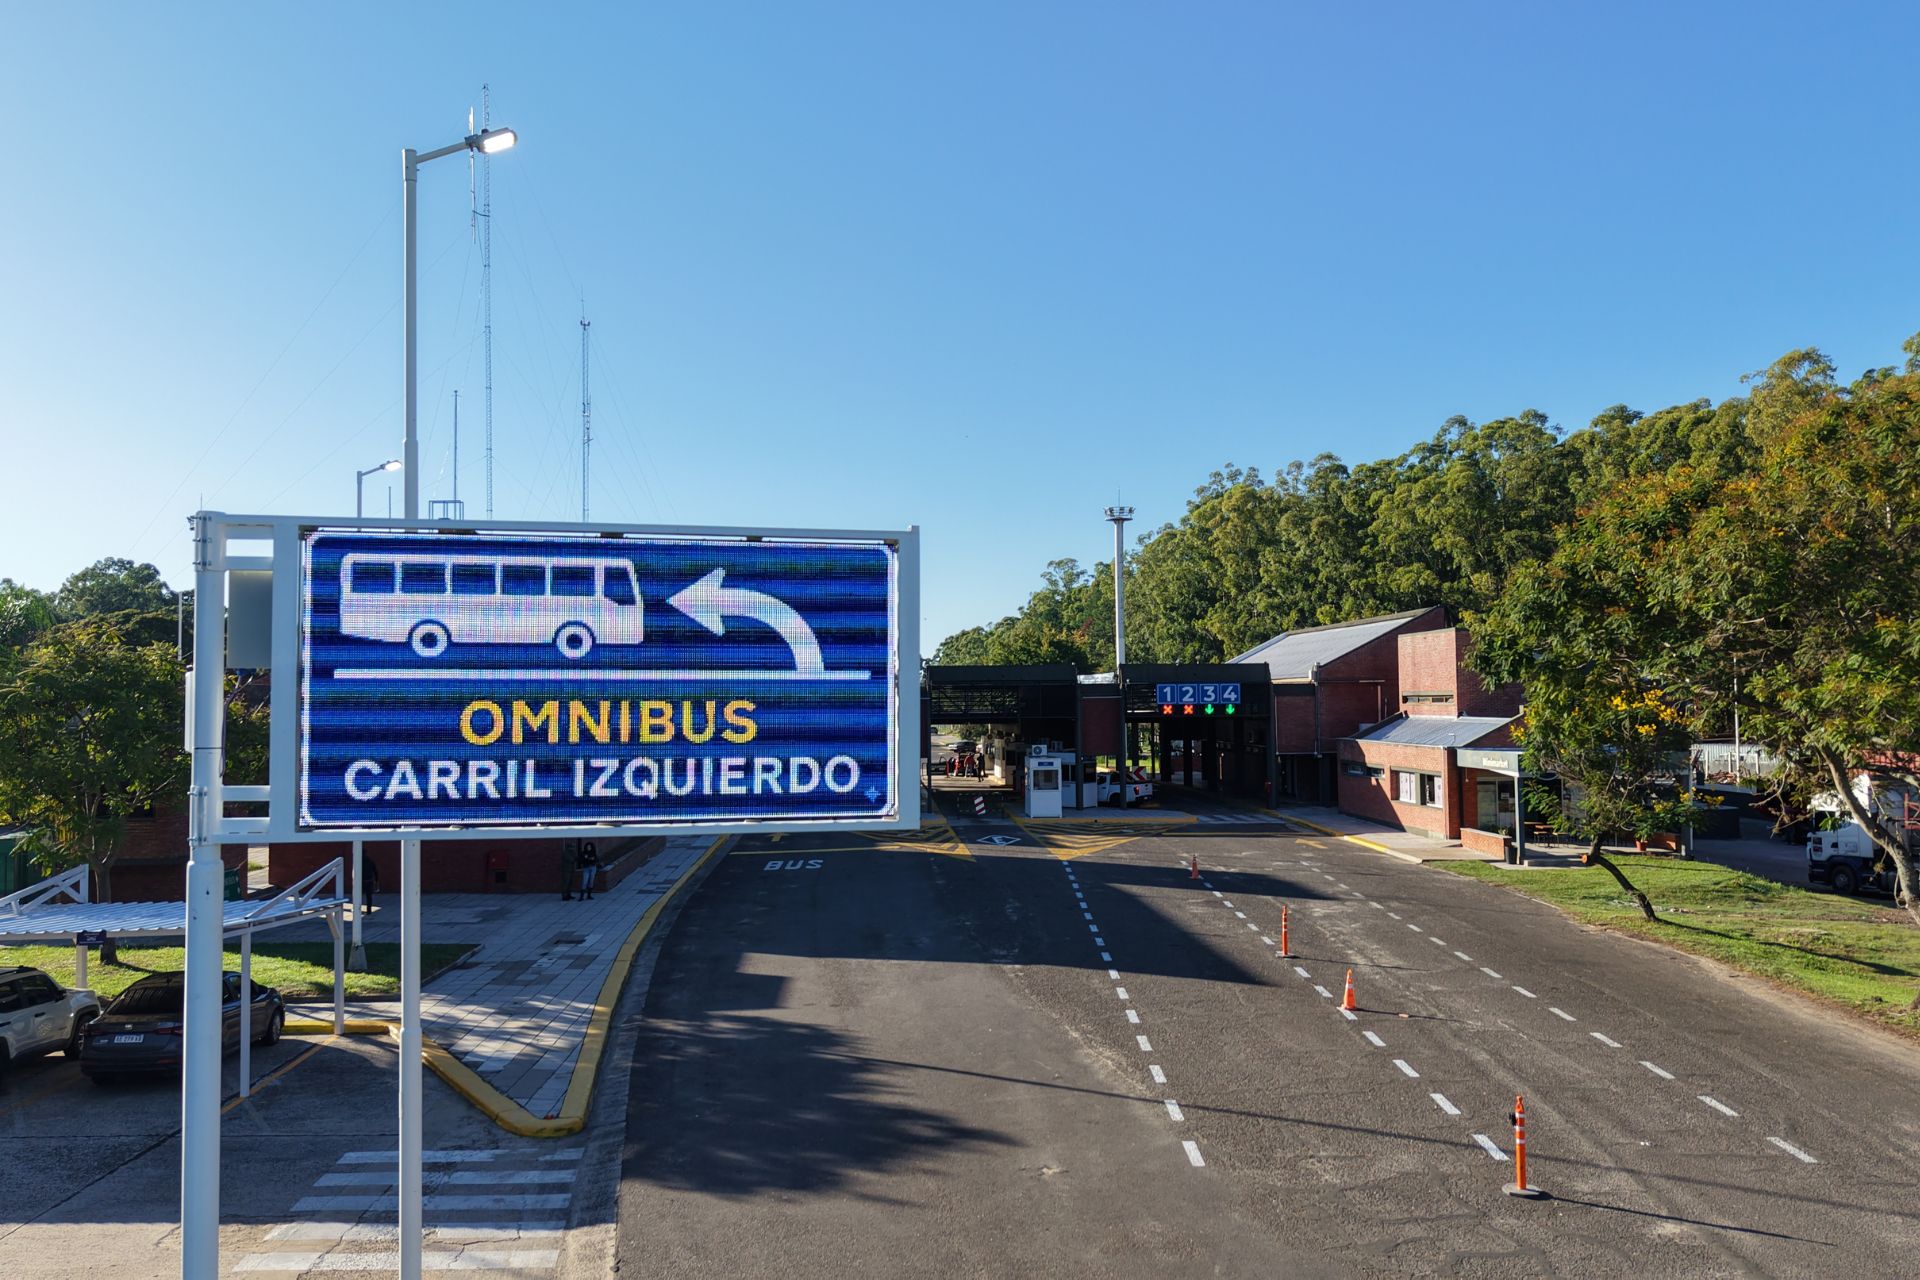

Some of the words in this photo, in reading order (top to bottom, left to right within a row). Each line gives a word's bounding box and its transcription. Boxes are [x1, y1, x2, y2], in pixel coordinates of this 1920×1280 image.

[1163, 686, 1172, 702] 1
[1182, 686, 1195, 702] 2
[1203, 685, 1216, 702] 3
[1223, 685, 1238, 701] 4
[459, 699, 759, 745] OMNIBUS
[344, 758, 552, 800] CARRIL
[573, 754, 861, 799] IZQUIERDO
[763, 859, 824, 871] BUS
